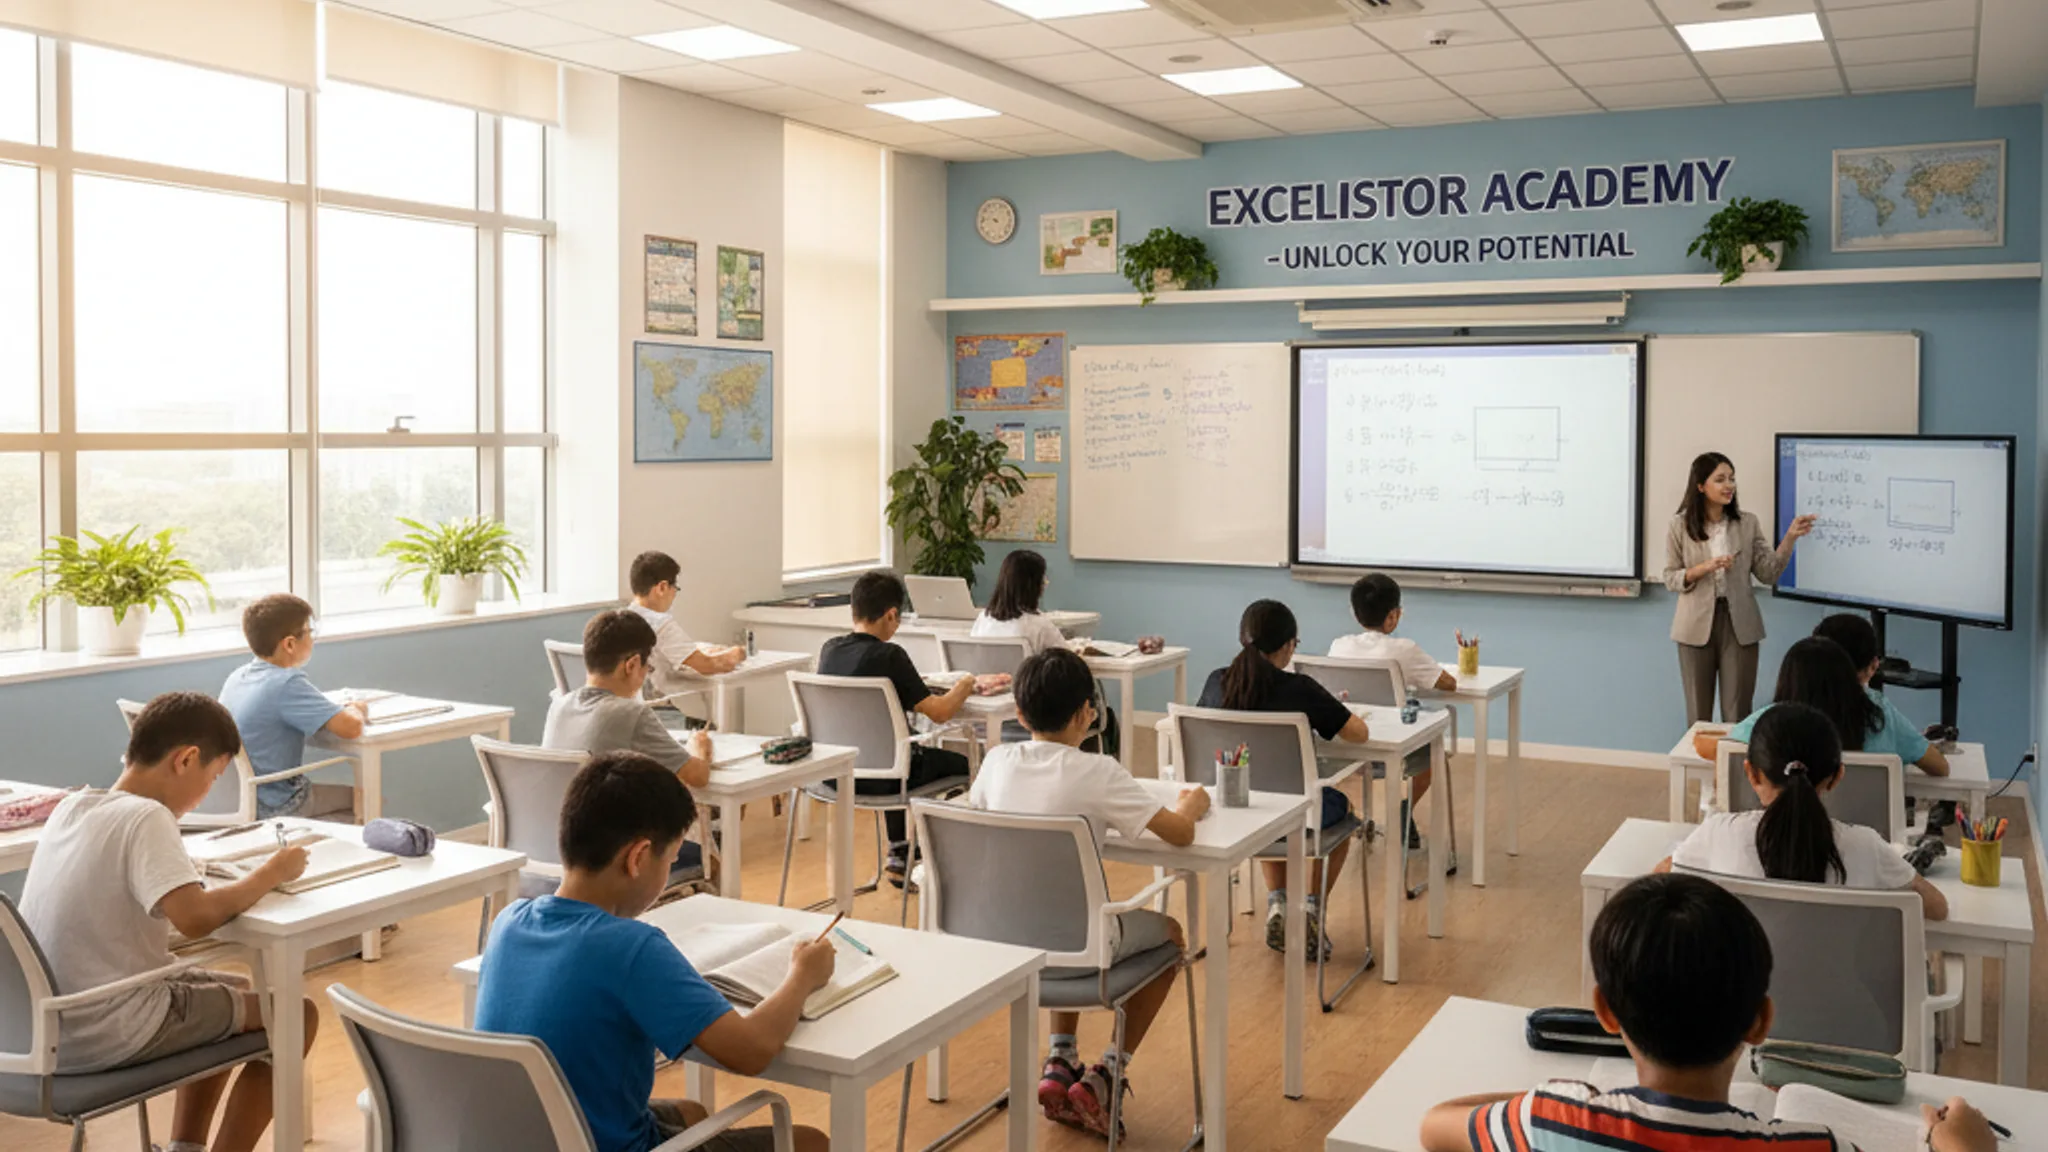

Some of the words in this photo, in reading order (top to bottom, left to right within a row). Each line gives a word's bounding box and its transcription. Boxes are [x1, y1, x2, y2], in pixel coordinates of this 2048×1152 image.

[1208, 176, 1469, 226] EXCELISTOR
[1481, 158, 1735, 213] ACADEMY
[1395, 239, 1471, 265] YOUR
[1478, 231, 1636, 263] POTENTIAL
